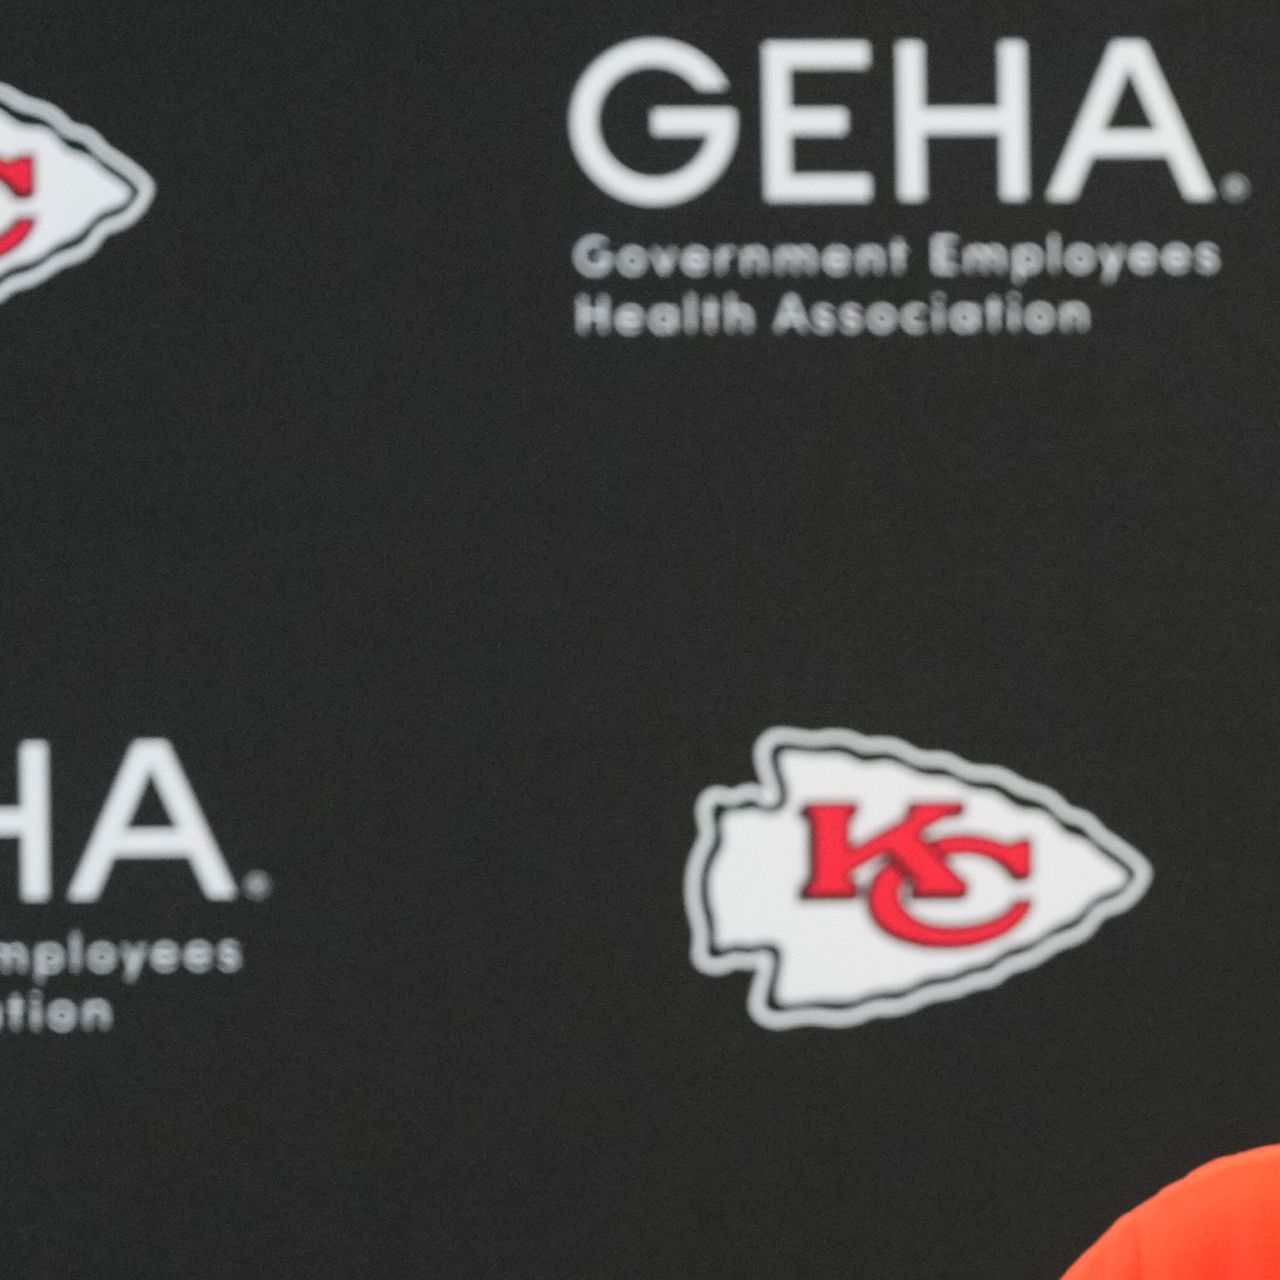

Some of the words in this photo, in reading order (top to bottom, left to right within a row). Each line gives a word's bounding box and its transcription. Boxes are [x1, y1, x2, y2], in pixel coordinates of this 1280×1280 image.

[570, 231, 911, 281] Government
[927, 230, 1223, 286] Employees
[572, 289, 758, 339] Health
[770, 289, 1093, 338] Association
[801, 801, 1033, 948] KC
